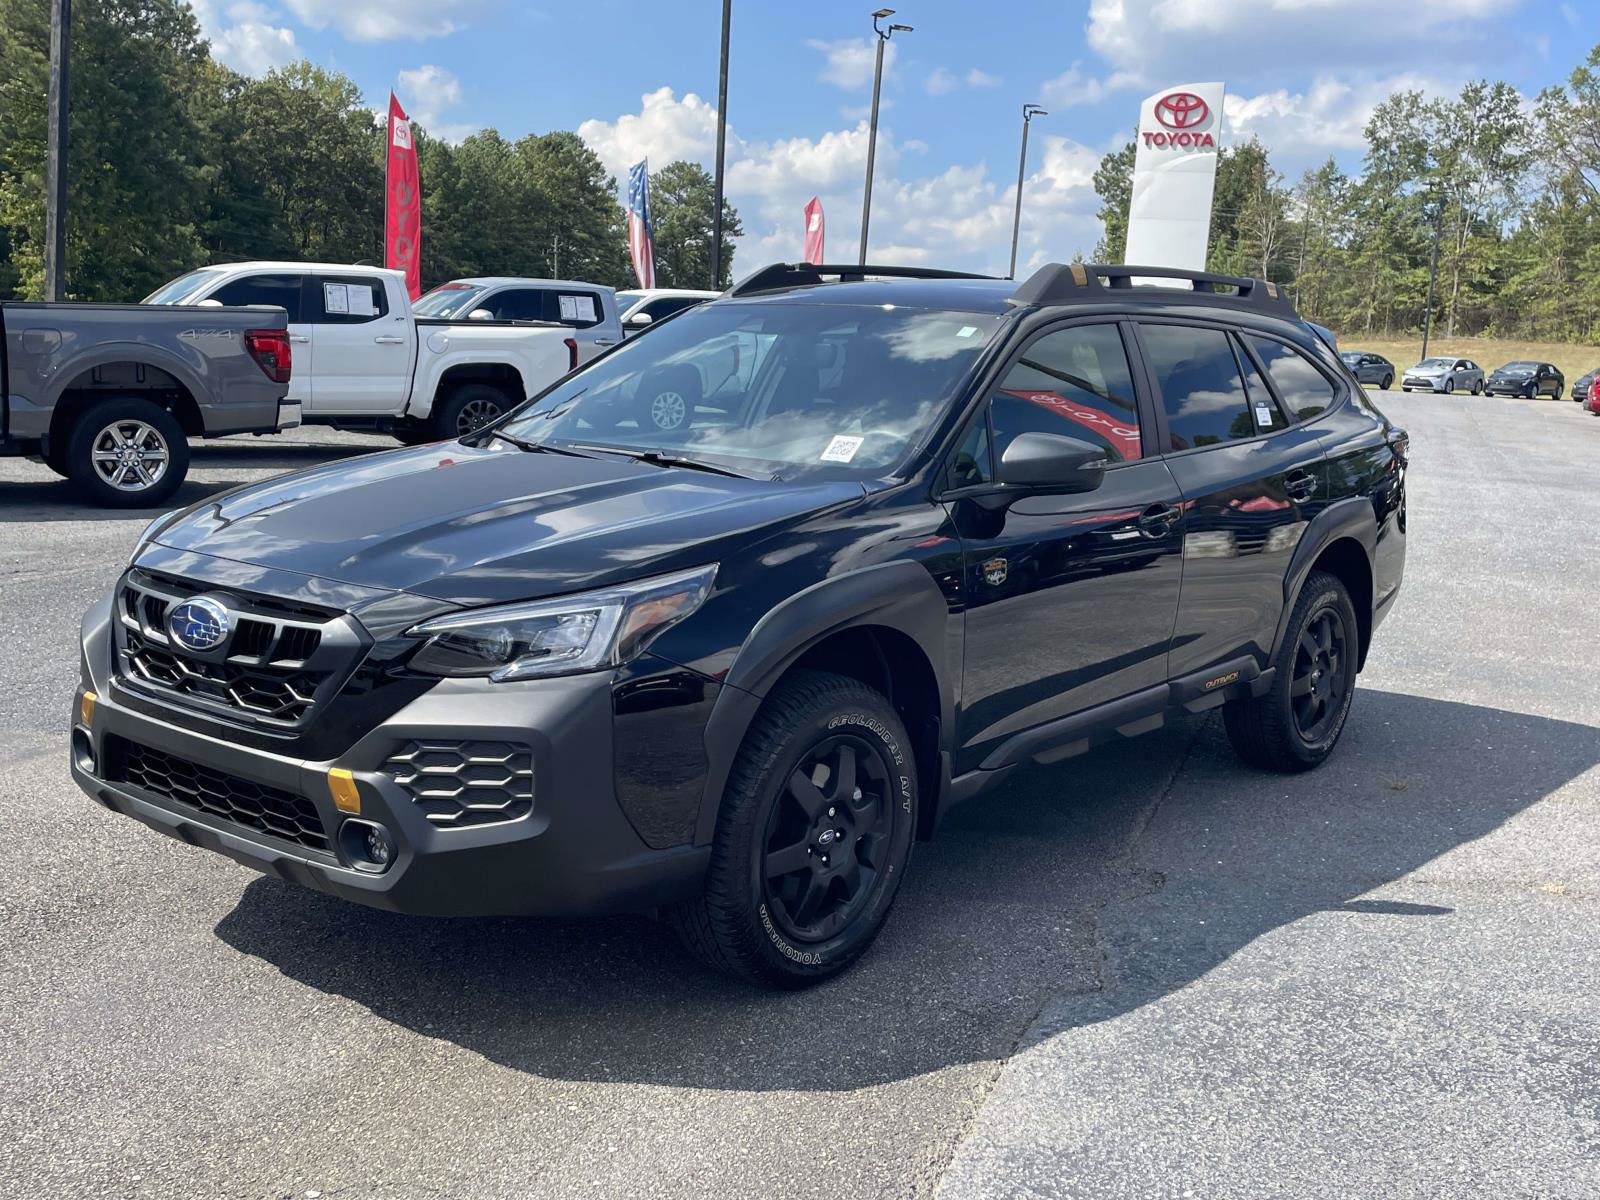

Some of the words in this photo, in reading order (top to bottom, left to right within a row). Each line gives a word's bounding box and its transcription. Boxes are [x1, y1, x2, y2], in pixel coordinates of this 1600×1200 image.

[1142, 132, 1214, 147] TOYOTA
[828, 713, 904, 766] GEOLANDAR
[759, 903, 822, 966] YOKOHAMA
